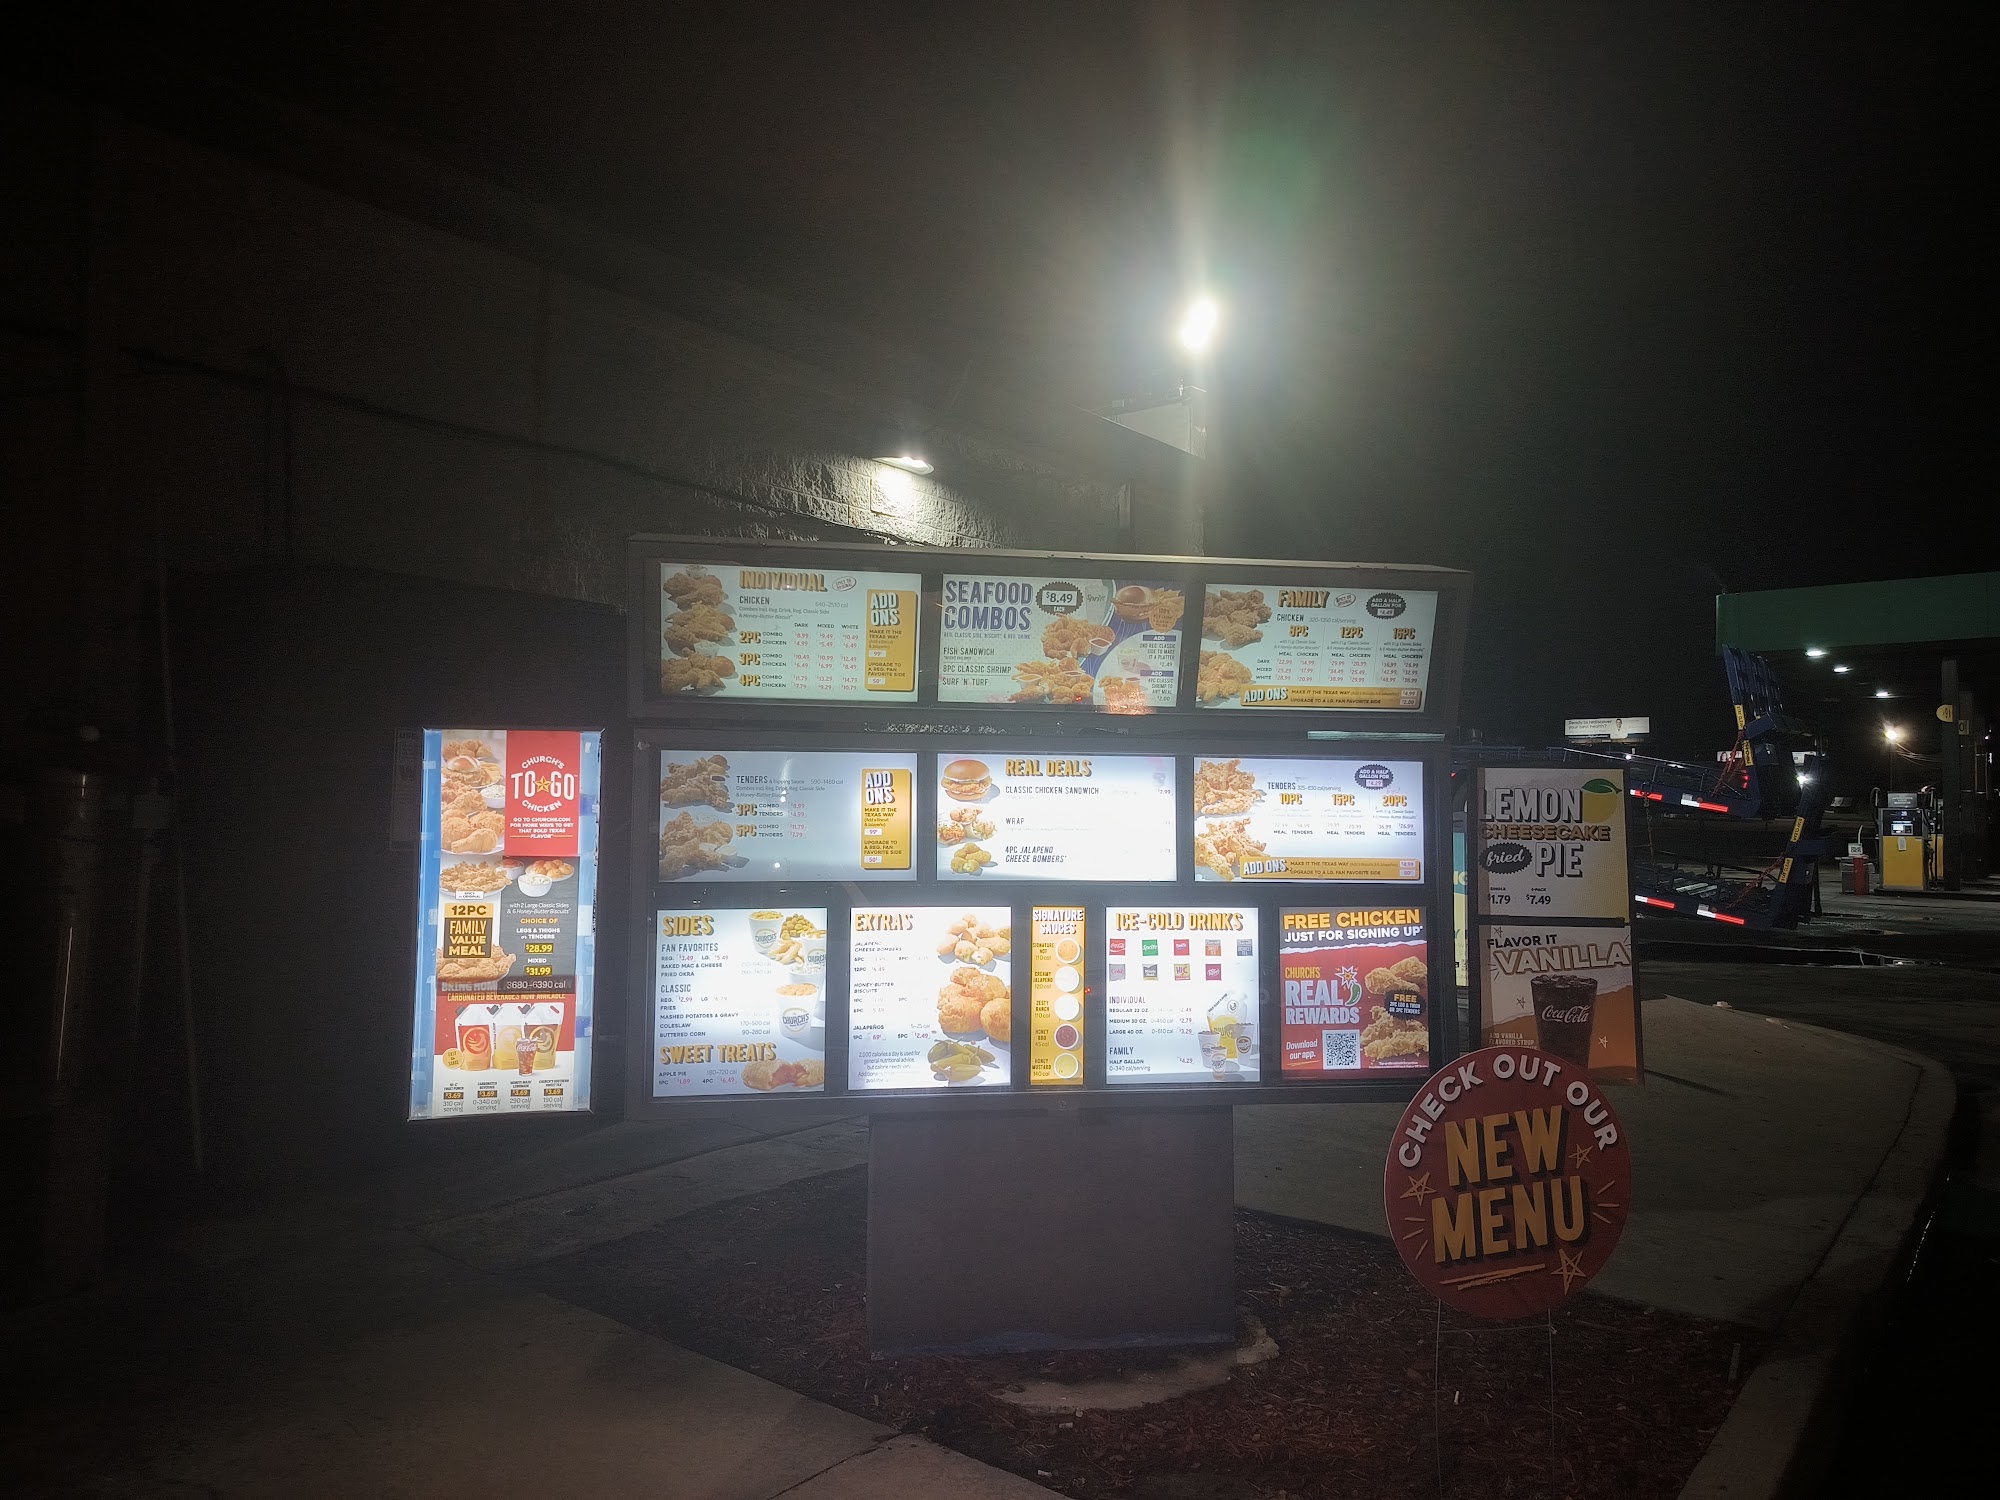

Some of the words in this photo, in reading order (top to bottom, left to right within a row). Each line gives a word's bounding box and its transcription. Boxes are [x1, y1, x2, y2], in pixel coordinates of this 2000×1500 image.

[740, 571, 827, 592] INDIVIDUAL
[945, 580, 1035, 606] SEAFOOD
[1045, 591, 1073, 603] $8.49
[1278, 590, 1331, 608] FAMILY
[740, 596, 769, 604] CHICKEN
[871, 592, 899, 610] ADD
[871, 608, 900, 626] ONS
[944, 605, 1033, 632] COMBOS
[1276, 613, 1304, 621] CHICKEN
[740, 631, 761, 644] 2PC
[1289, 625, 1309, 637] 8PC
[1340, 627, 1363, 638] 12PC
[1392, 627, 1416, 640] 16PC
[943, 647, 958, 655] FISH
[960, 647, 995, 656] SANDWICH
[740, 653, 761, 665] 3PC
[943, 665, 956, 673] 8PC
[957, 665, 985, 673] CLASSIC
[986, 666, 1011, 674] SHRIMP
[740, 675, 761, 686] 4PC
[942, 678, 959, 686] SURF
[972, 678, 988, 686] TURF
[1244, 690, 1264, 702] ADD
[1266, 688, 1288, 701] ONS
[521, 755, 565, 770] CHURCH'S
[1005, 759, 1043, 777] REAL
[1046, 760, 1093, 778] DEALS
[511, 770, 536, 799] TO
[551, 772, 575, 800] GO
[736, 775, 768, 784] TENDERS
[865, 771, 893, 788] ADD
[1267, 782, 1296, 790] TENDERS
[865, 787, 895, 805] ONS
[1005, 786, 1033, 795] CLASSIC
[1035, 786, 1063, 795] CHICKEN
[1065, 786, 1099, 795] SANDWICH
[521, 800, 563, 813] CHICKEN
[1279, 793, 1302, 805] 10PC
[1332, 794, 1356, 805] 15PC
[1382, 794, 1408, 807] 20PC
[1479, 788, 1584, 823] LEMON
[736, 803, 757, 816] 3PC
[1005, 817, 1025, 825] WRAP
[735, 824, 757, 837] 5PC
[1479, 824, 1611, 841] CHEESECAKE
[1005, 846, 1018, 854] 4PC
[1005, 855, 1030, 863] CHEESE
[1486, 849, 1525, 866] fried
[1535, 842, 1583, 877] PIE
[1243, 861, 1264, 875] ADD
[1265, 860, 1288, 873] ONS
[1488, 894, 1511, 905] $1.79
[1525, 894, 1551, 905] $7.49
[451, 905, 487, 915] 12PC
[1033, 909, 1084, 921] SIGNATURE
[662, 915, 715, 937] SIDES
[855, 913, 914, 932] EXTRAS
[1116, 912, 1184, 931] ICE-COLD
[1188, 912, 1244, 931] DRINKS
[1283, 913, 1331, 930] FREE
[1336, 909, 1420, 928] CHICKEN
[449, 920, 487, 935] FAMILY
[1040, 923, 1077, 935] SAUCES
[449, 936, 486, 944] VALUE
[1284, 931, 1315, 943] JUST
[1318, 929, 1343, 941] FOR
[1347, 926, 1400, 939] SIGNING
[526, 944, 553, 952] $28.99
[661, 944, 676, 952] FAN
[678, 943, 719, 952] FAVORITES
[1487, 935, 1542, 949] FLAVOR
[1546, 934, 1557, 945] IT
[448, 945, 486, 956] MEAL
[1493, 941, 1631, 976] VANILLA
[526, 967, 551, 975] $31.99
[1285, 966, 1321, 979] CHURCH'S
[554, 981, 566, 989] cal
[660, 984, 691, 993] CLASSIC
[1285, 979, 1344, 1006] REAL
[1393, 994, 1417, 1002] FREE
[1109, 996, 1146, 1004] INDIVIDUAL
[1285, 1006, 1360, 1025] REWARDS
[1541, 1004, 1591, 1023] Coca-Cola
[1501, 1032, 1523, 1040] VANILLA
[1286, 1038, 1318, 1050] Download
[660, 1044, 713, 1065] SWEET
[717, 1042, 777, 1063] TREATS
[1109, 1046, 1134, 1056] FAMILY
[1289, 1052, 1301, 1060] our
[1301, 1052, 1316, 1060] app.
[1398, 1061, 1484, 1168] CHECK
[1493, 1053, 1562, 1087] OUT
[1566, 1081, 1618, 1150] OUR
[1444, 1104, 1566, 1187] NEW
[1431, 1175, 1587, 1264] MENU
